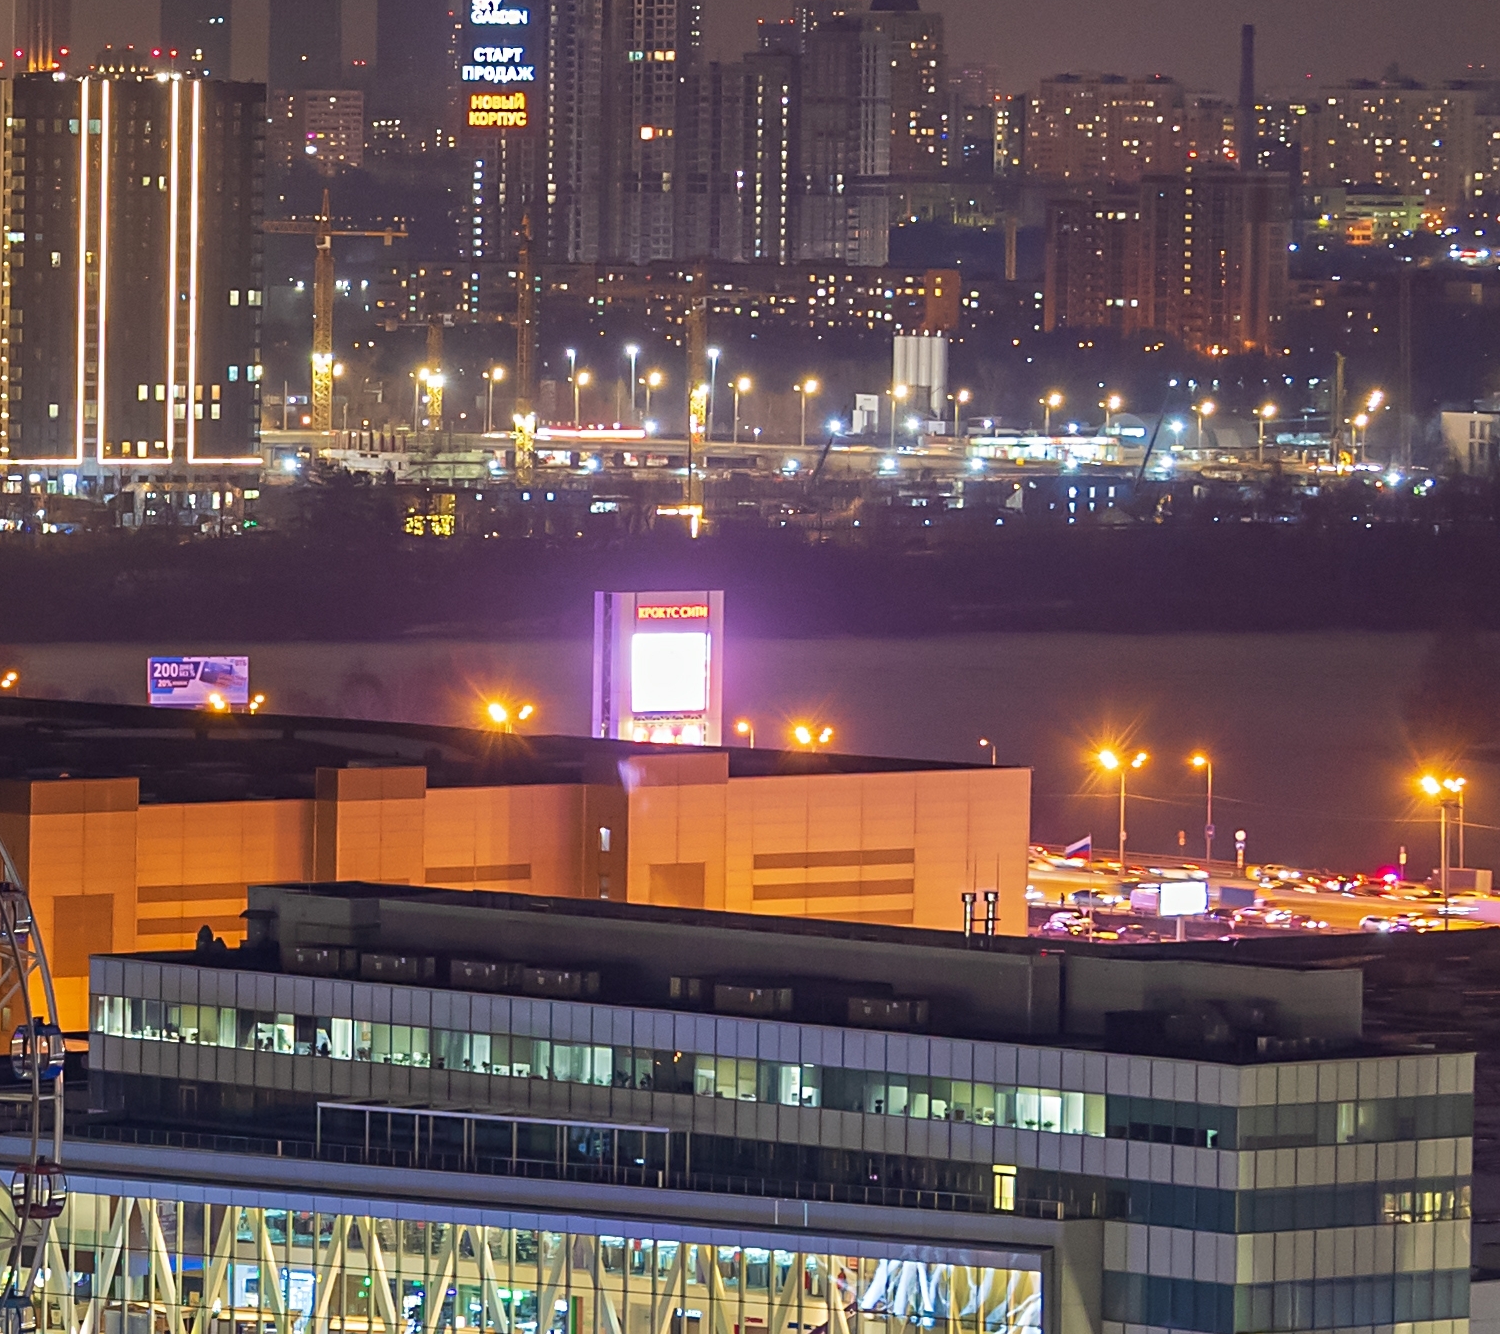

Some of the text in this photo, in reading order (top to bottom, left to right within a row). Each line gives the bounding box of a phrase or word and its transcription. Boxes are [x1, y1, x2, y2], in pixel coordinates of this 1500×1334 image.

[470, 10, 528, 25] GARDEN
[473, 47, 523, 62] СТАРТ
[462, 65, 534, 83] ПРОДАЖ
[471, 92, 525, 110] НОВЫЙ
[468, 111, 527, 126] КОРПУС
[638, 606, 708, 619] КРОКУС СИТИ
[153, 663, 179, 678] 200
